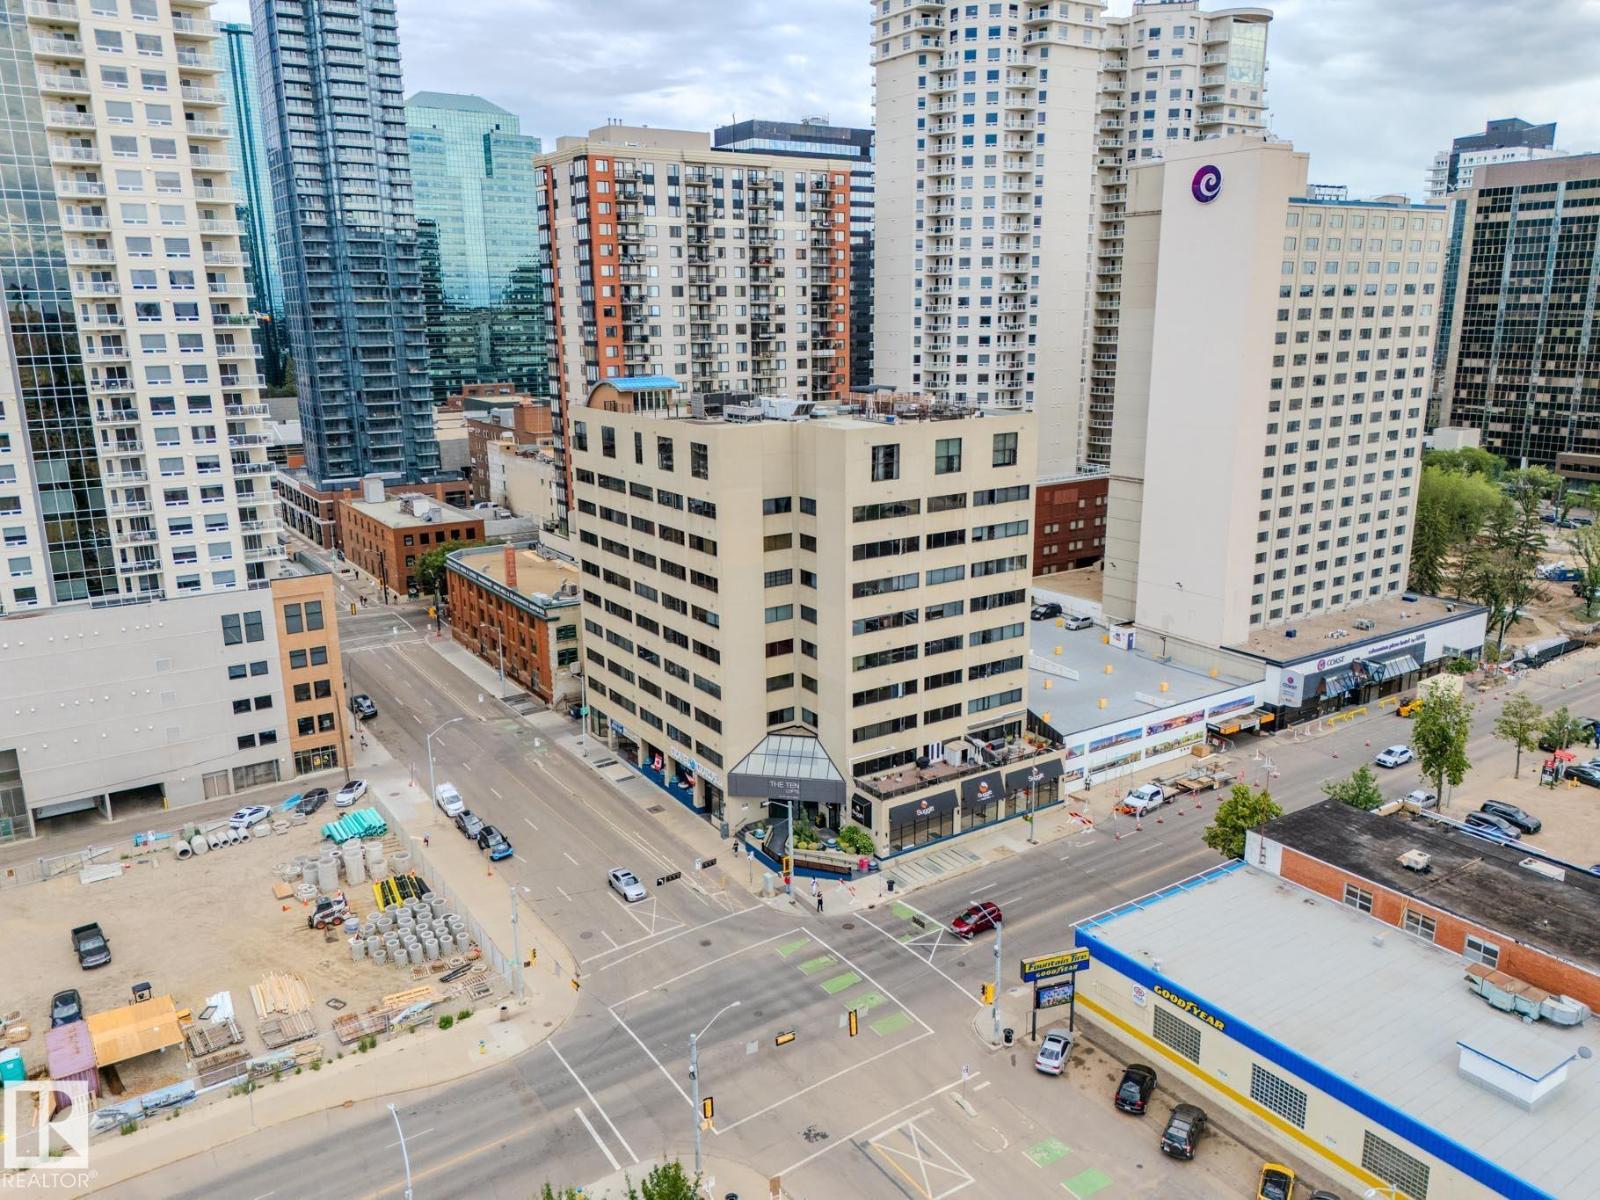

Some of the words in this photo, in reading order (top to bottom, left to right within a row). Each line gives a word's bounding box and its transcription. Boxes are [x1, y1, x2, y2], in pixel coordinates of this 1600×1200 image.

[769, 780, 785, 789] THE
[785, 781, 800, 790] TEN
[1026, 957, 1070, 972] Fountain
[1071, 952, 1087, 962] Tire
[1153, 985, 1225, 1031] GOODYEAR
